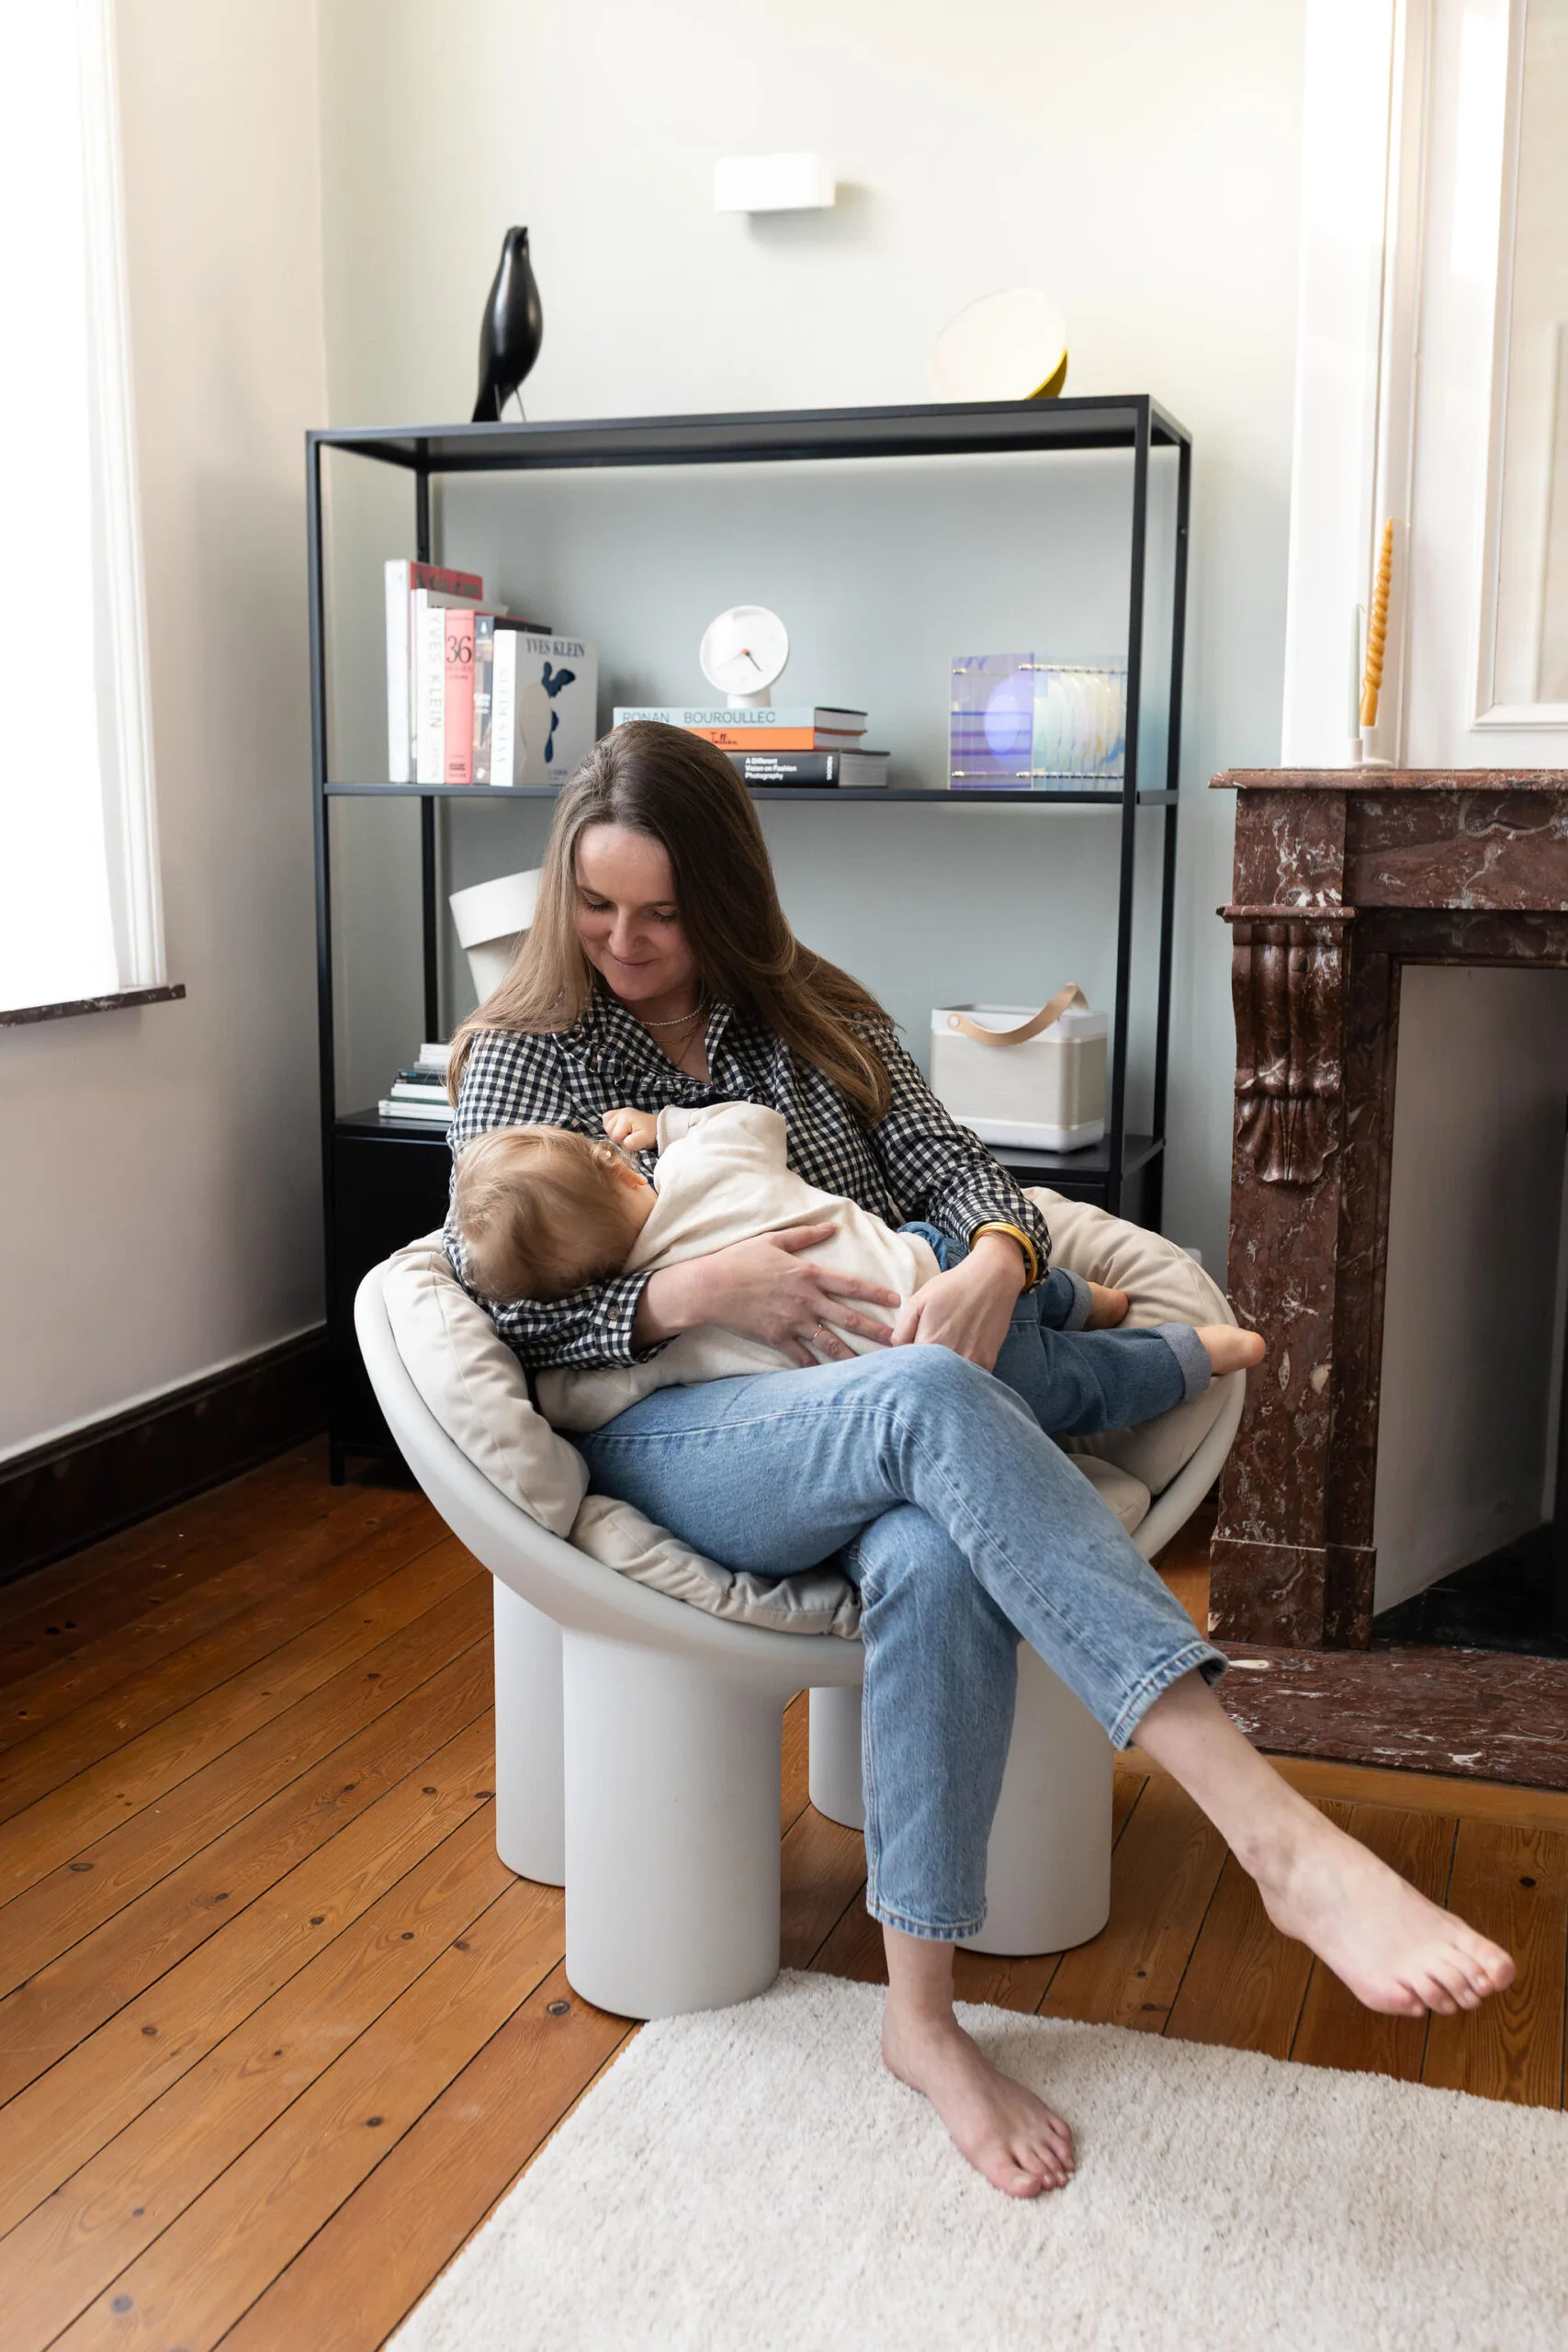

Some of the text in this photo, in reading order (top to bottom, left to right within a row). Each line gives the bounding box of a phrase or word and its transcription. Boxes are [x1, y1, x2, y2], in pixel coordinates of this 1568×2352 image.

[429, 615, 443, 663] YVES
[446, 634, 472, 664] 36
[526, 638, 586, 658] YVES KLEIN
[429, 673, 443, 729] KLEIN
[622, 711, 776, 723] RONAN BOUROULLEC
[745, 771, 784, 780] Photography
